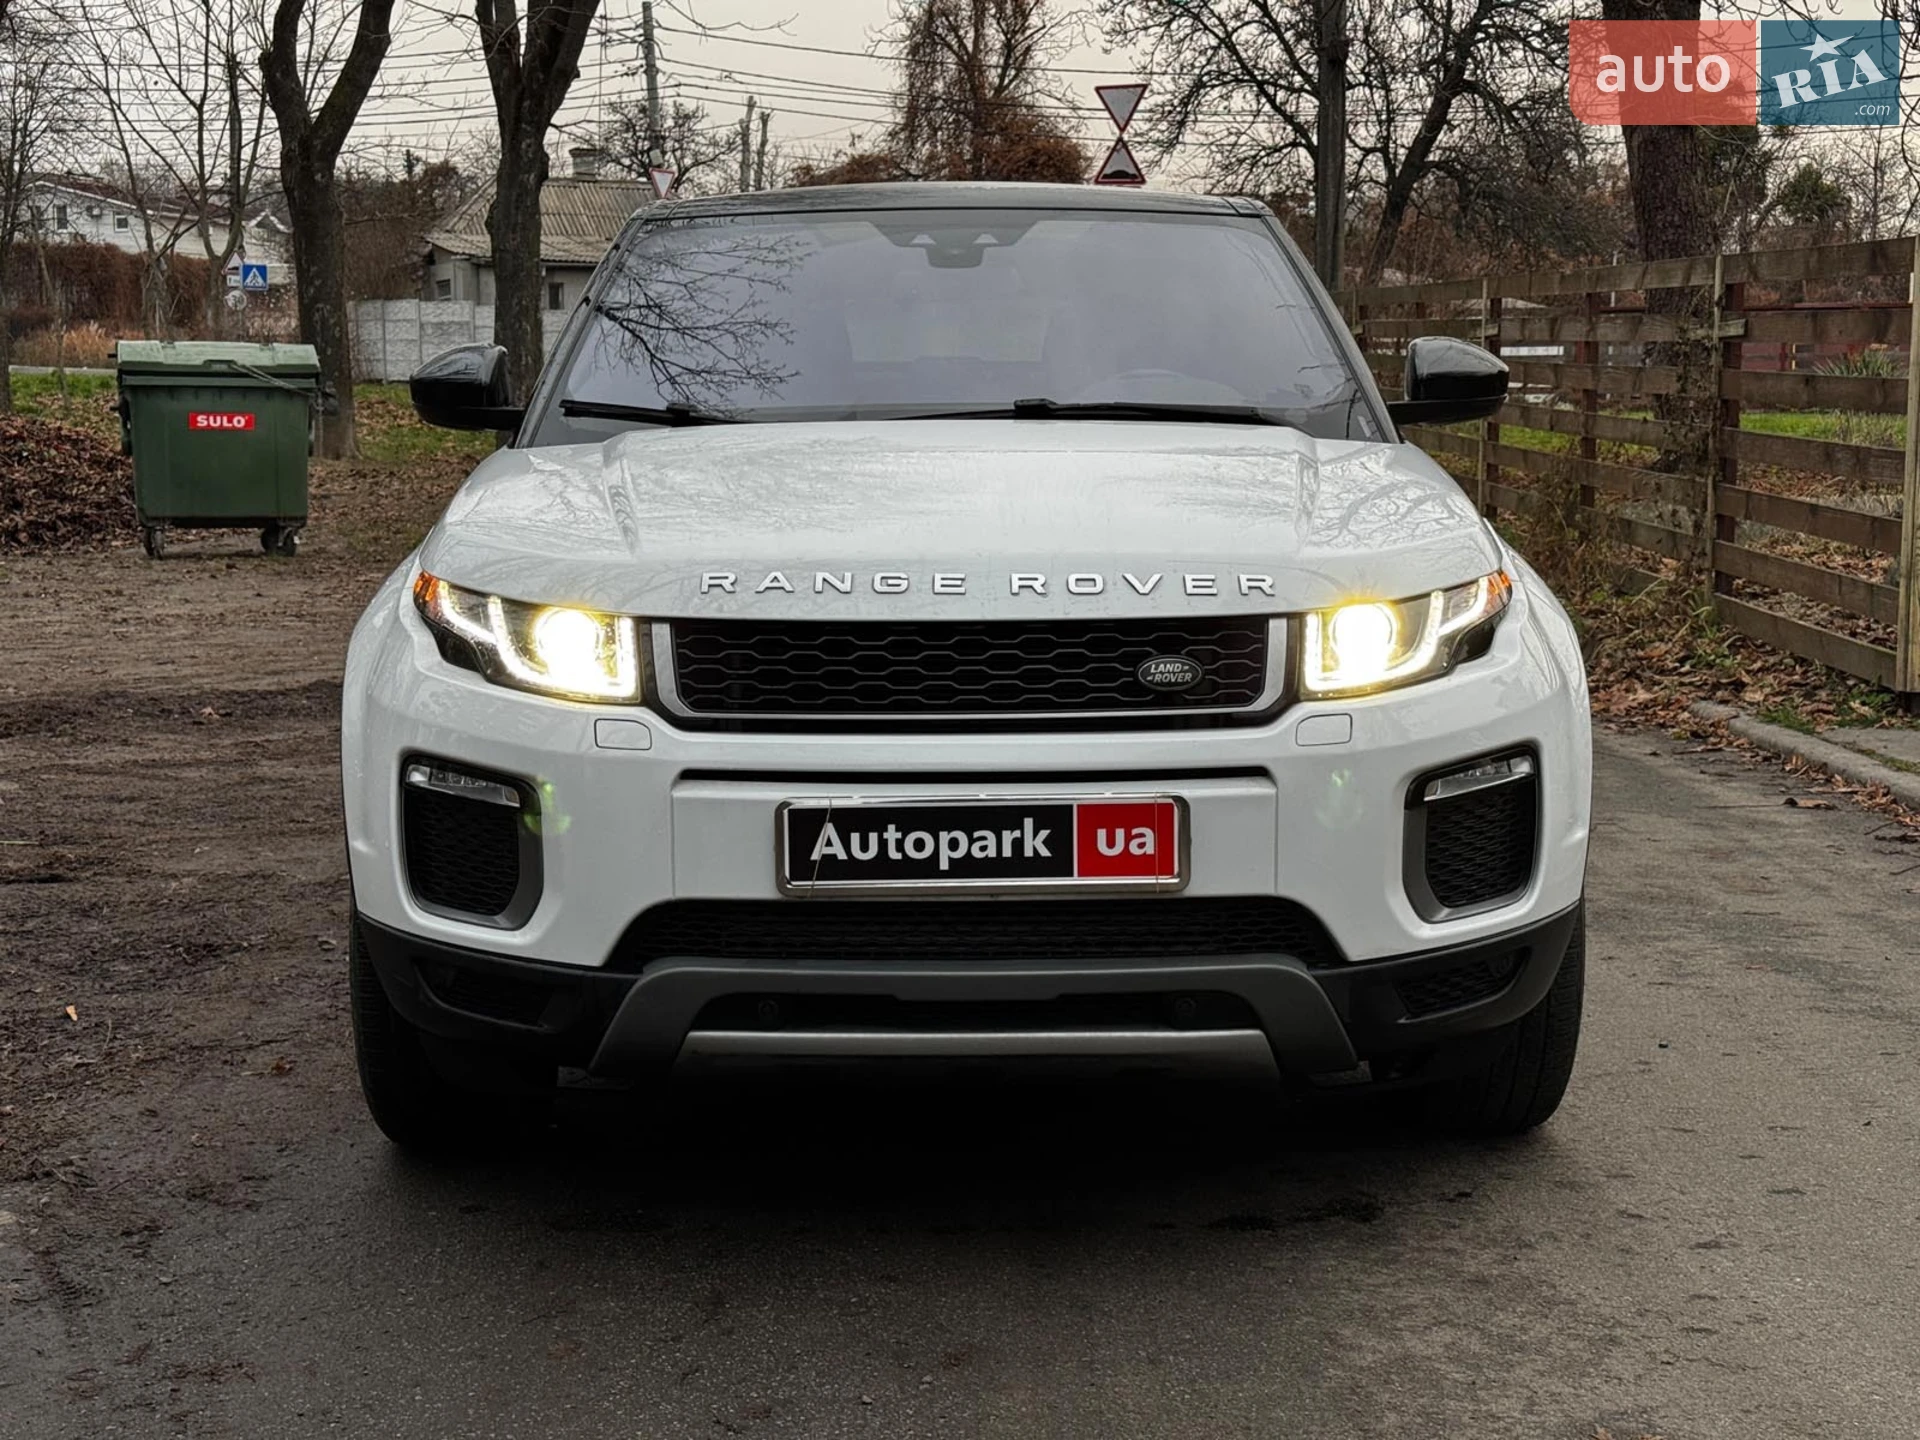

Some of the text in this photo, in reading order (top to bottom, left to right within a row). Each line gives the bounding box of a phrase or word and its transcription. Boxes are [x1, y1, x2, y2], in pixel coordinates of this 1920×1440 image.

[196, 414, 247, 428] SULO
[700, 571, 1276, 597] RANGE ROVER
[1152, 673, 1193, 683] ROVER
[809, 817, 1156, 871] Autopark ua
